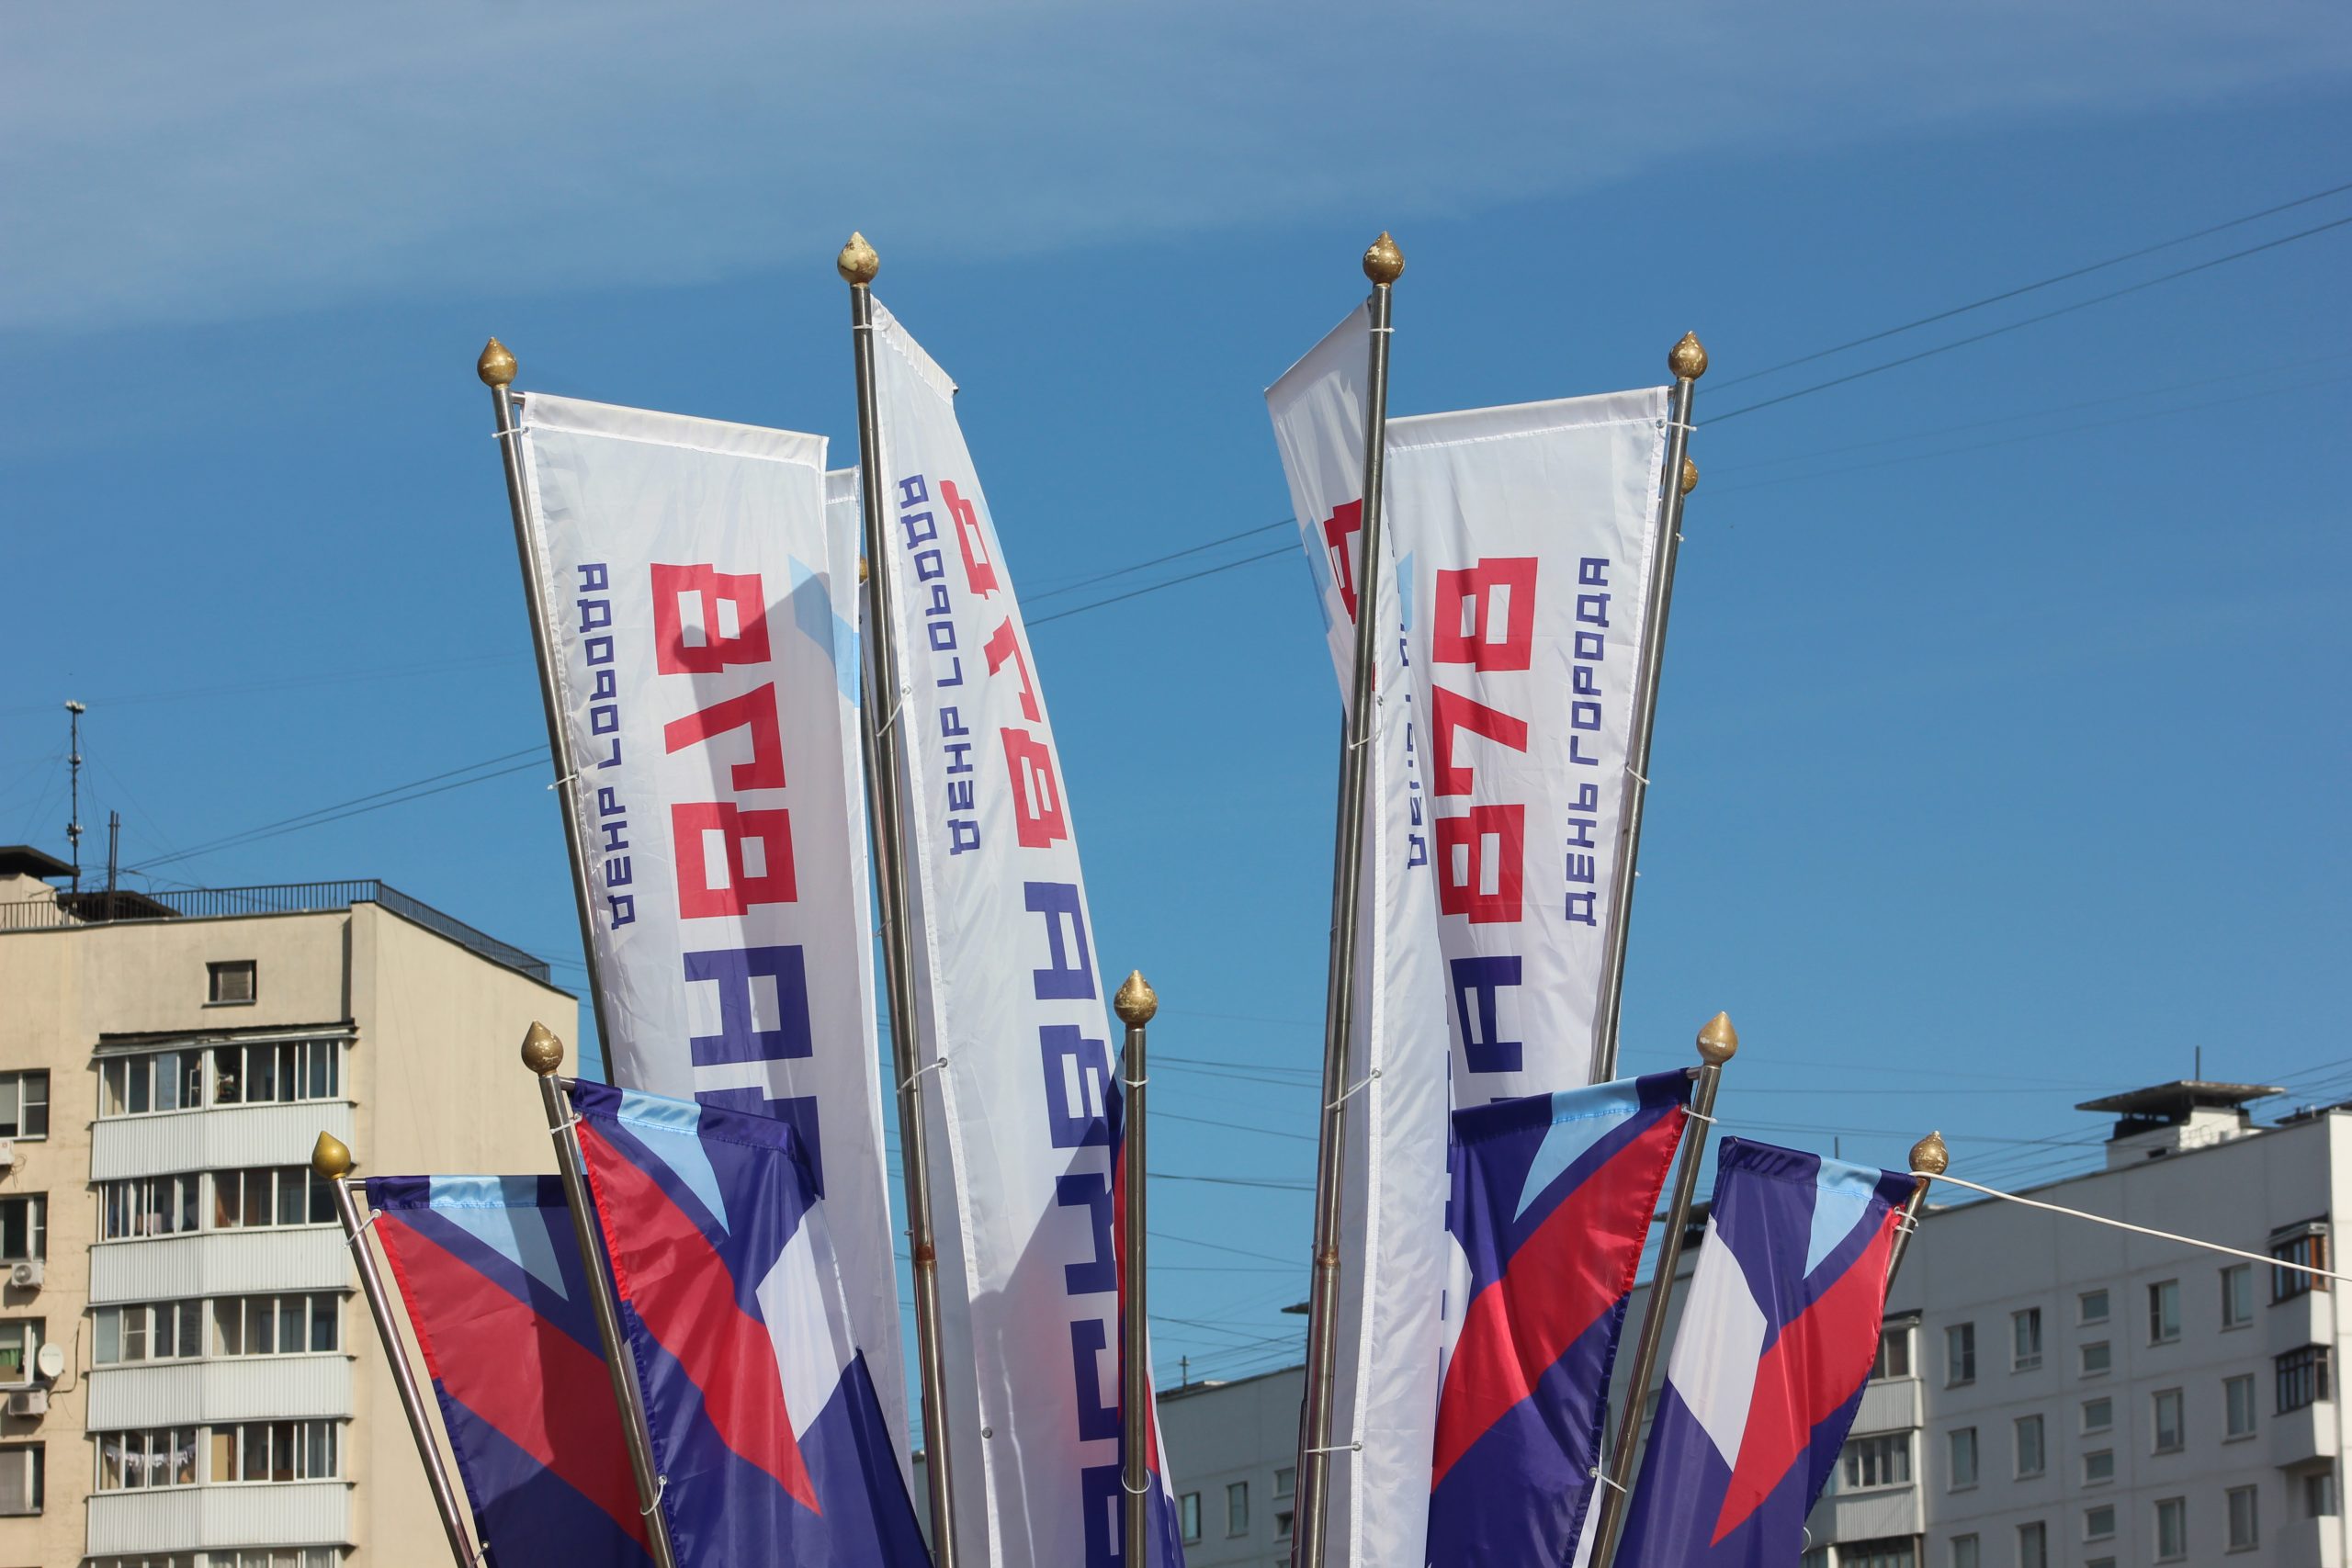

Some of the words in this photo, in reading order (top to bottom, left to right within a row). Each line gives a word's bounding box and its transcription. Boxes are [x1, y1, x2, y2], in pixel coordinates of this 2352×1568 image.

[1431, 556, 1539, 925] 878
[1569, 557, 1611, 766] ГОРОДА
[1566, 784, 1599, 928] ДЕНЬ
